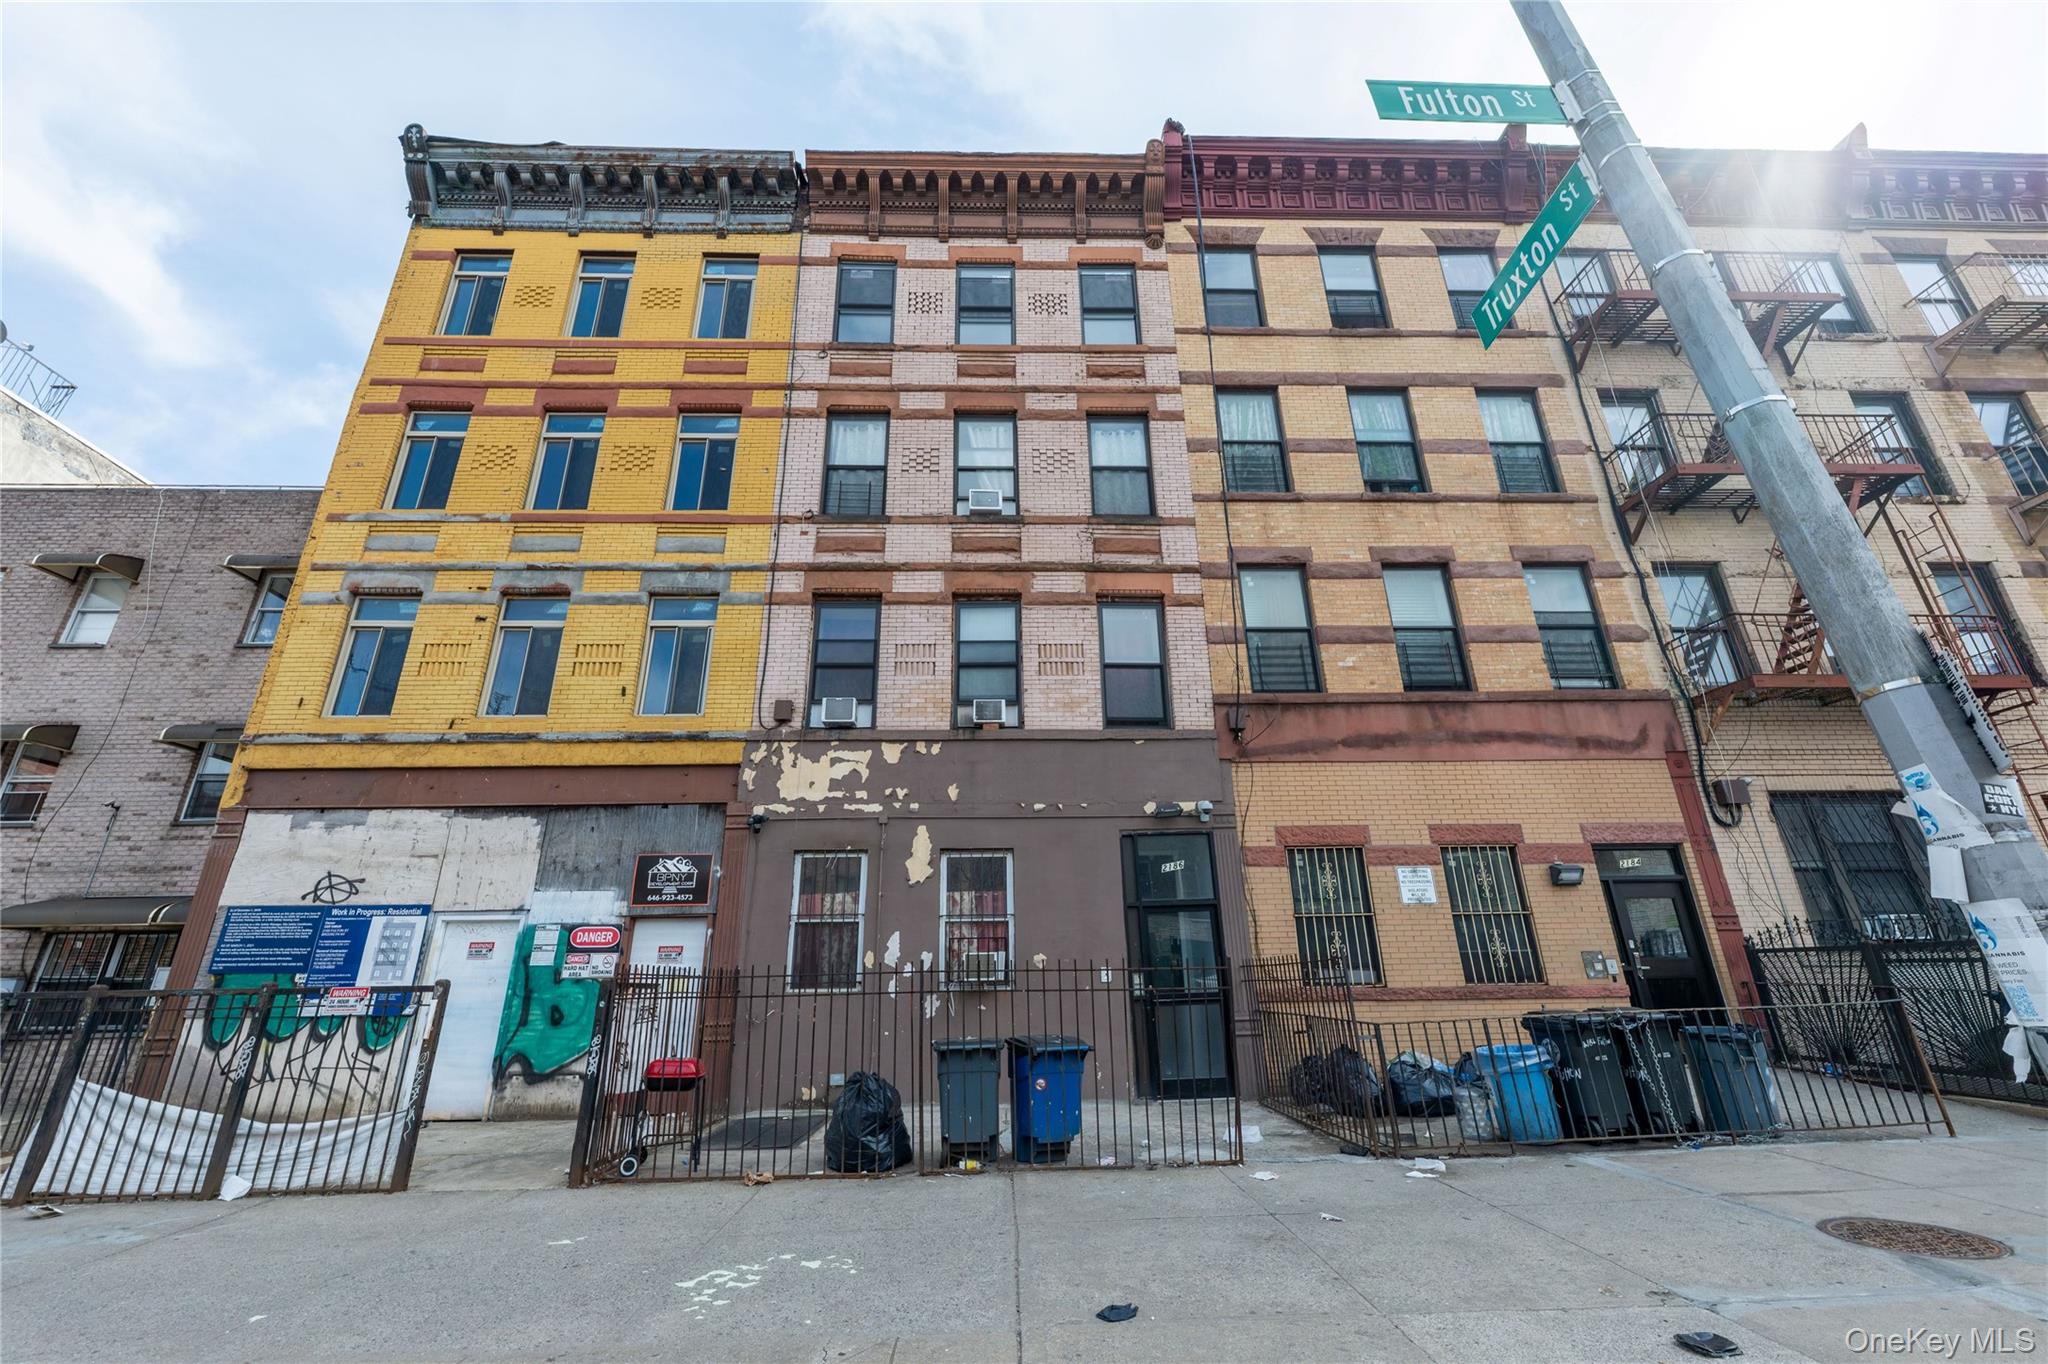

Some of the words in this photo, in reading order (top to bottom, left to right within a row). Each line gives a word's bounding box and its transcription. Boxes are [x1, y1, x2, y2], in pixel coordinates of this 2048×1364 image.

[1397, 86, 1504, 117] Fulton
[1511, 89, 1537, 108] St
[1481, 222, 1560, 330] Truxton
[1559, 181, 1580, 212] St
[1161, 860, 1184, 873] 2186
[1620, 857, 1641, 869] 2184
[656, 873, 687, 882] BPNY
[331, 908, 348, 916] Work
[356, 908, 387, 917] Progress:
[387, 907, 423, 915] Residential
[576, 931, 614, 943] DANGER
[332, 989, 367, 997] WARNING
